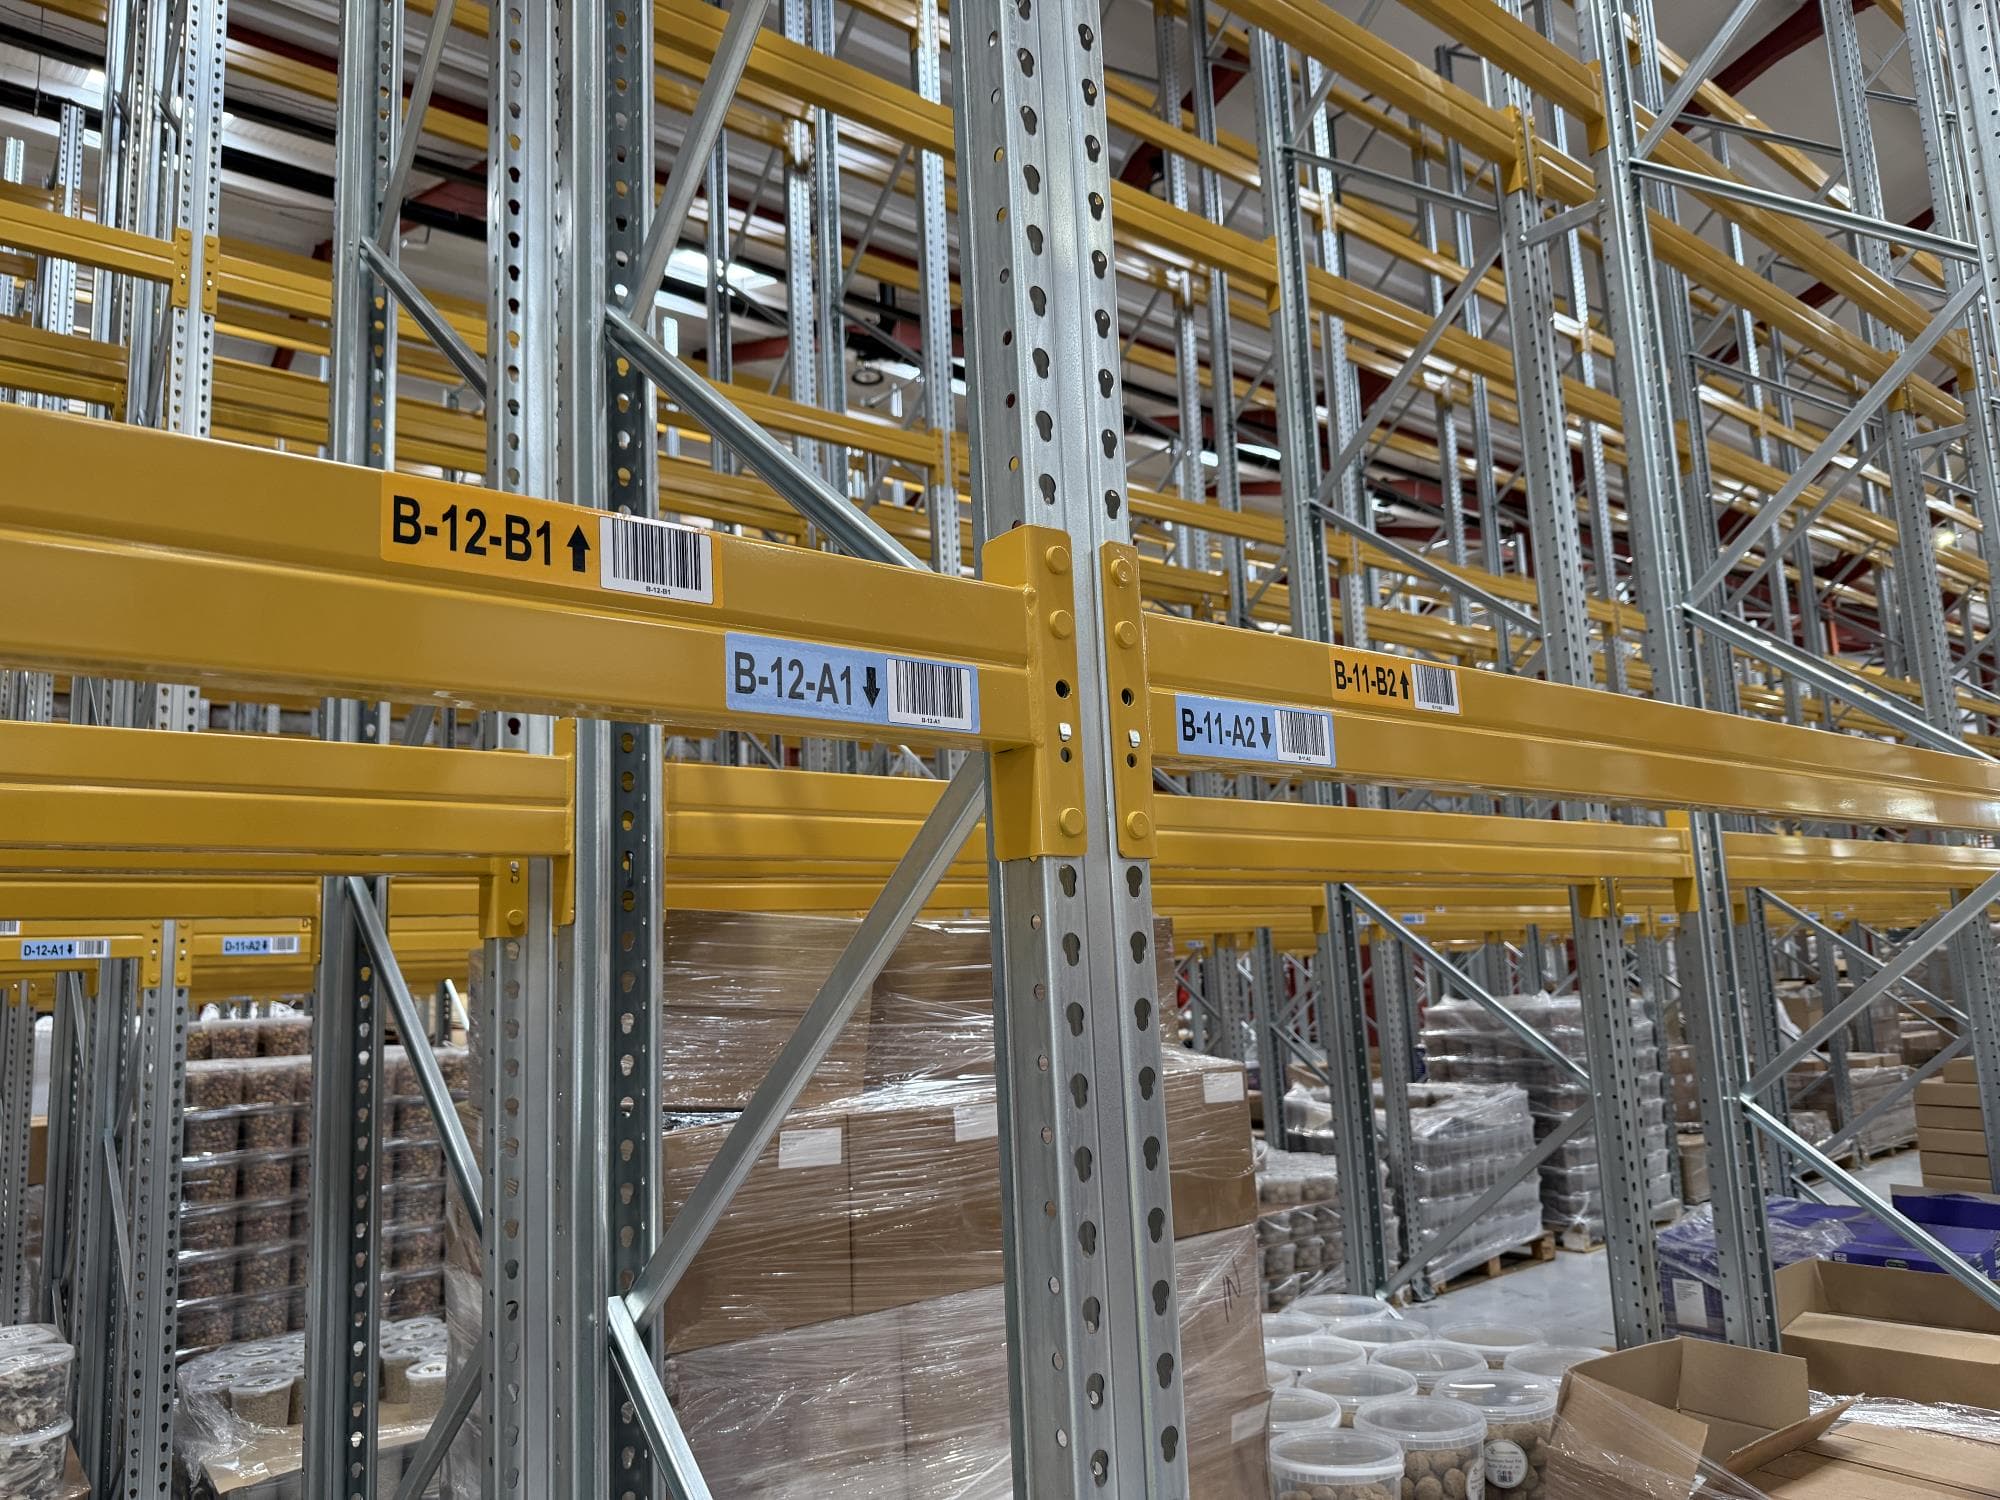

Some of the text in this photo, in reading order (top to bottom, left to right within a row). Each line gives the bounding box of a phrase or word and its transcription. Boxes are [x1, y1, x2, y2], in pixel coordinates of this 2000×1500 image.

[392, 495, 551, 566] B-12-B1
[734, 651, 852, 706] B-12-A1
[1334, 659, 1397, 698] B-11-B2
[1182, 708, 1257, 749] B-11-A2
[23, 942, 65, 956] D-12-A1
[225, 941, 262, 951] D-11-A2
